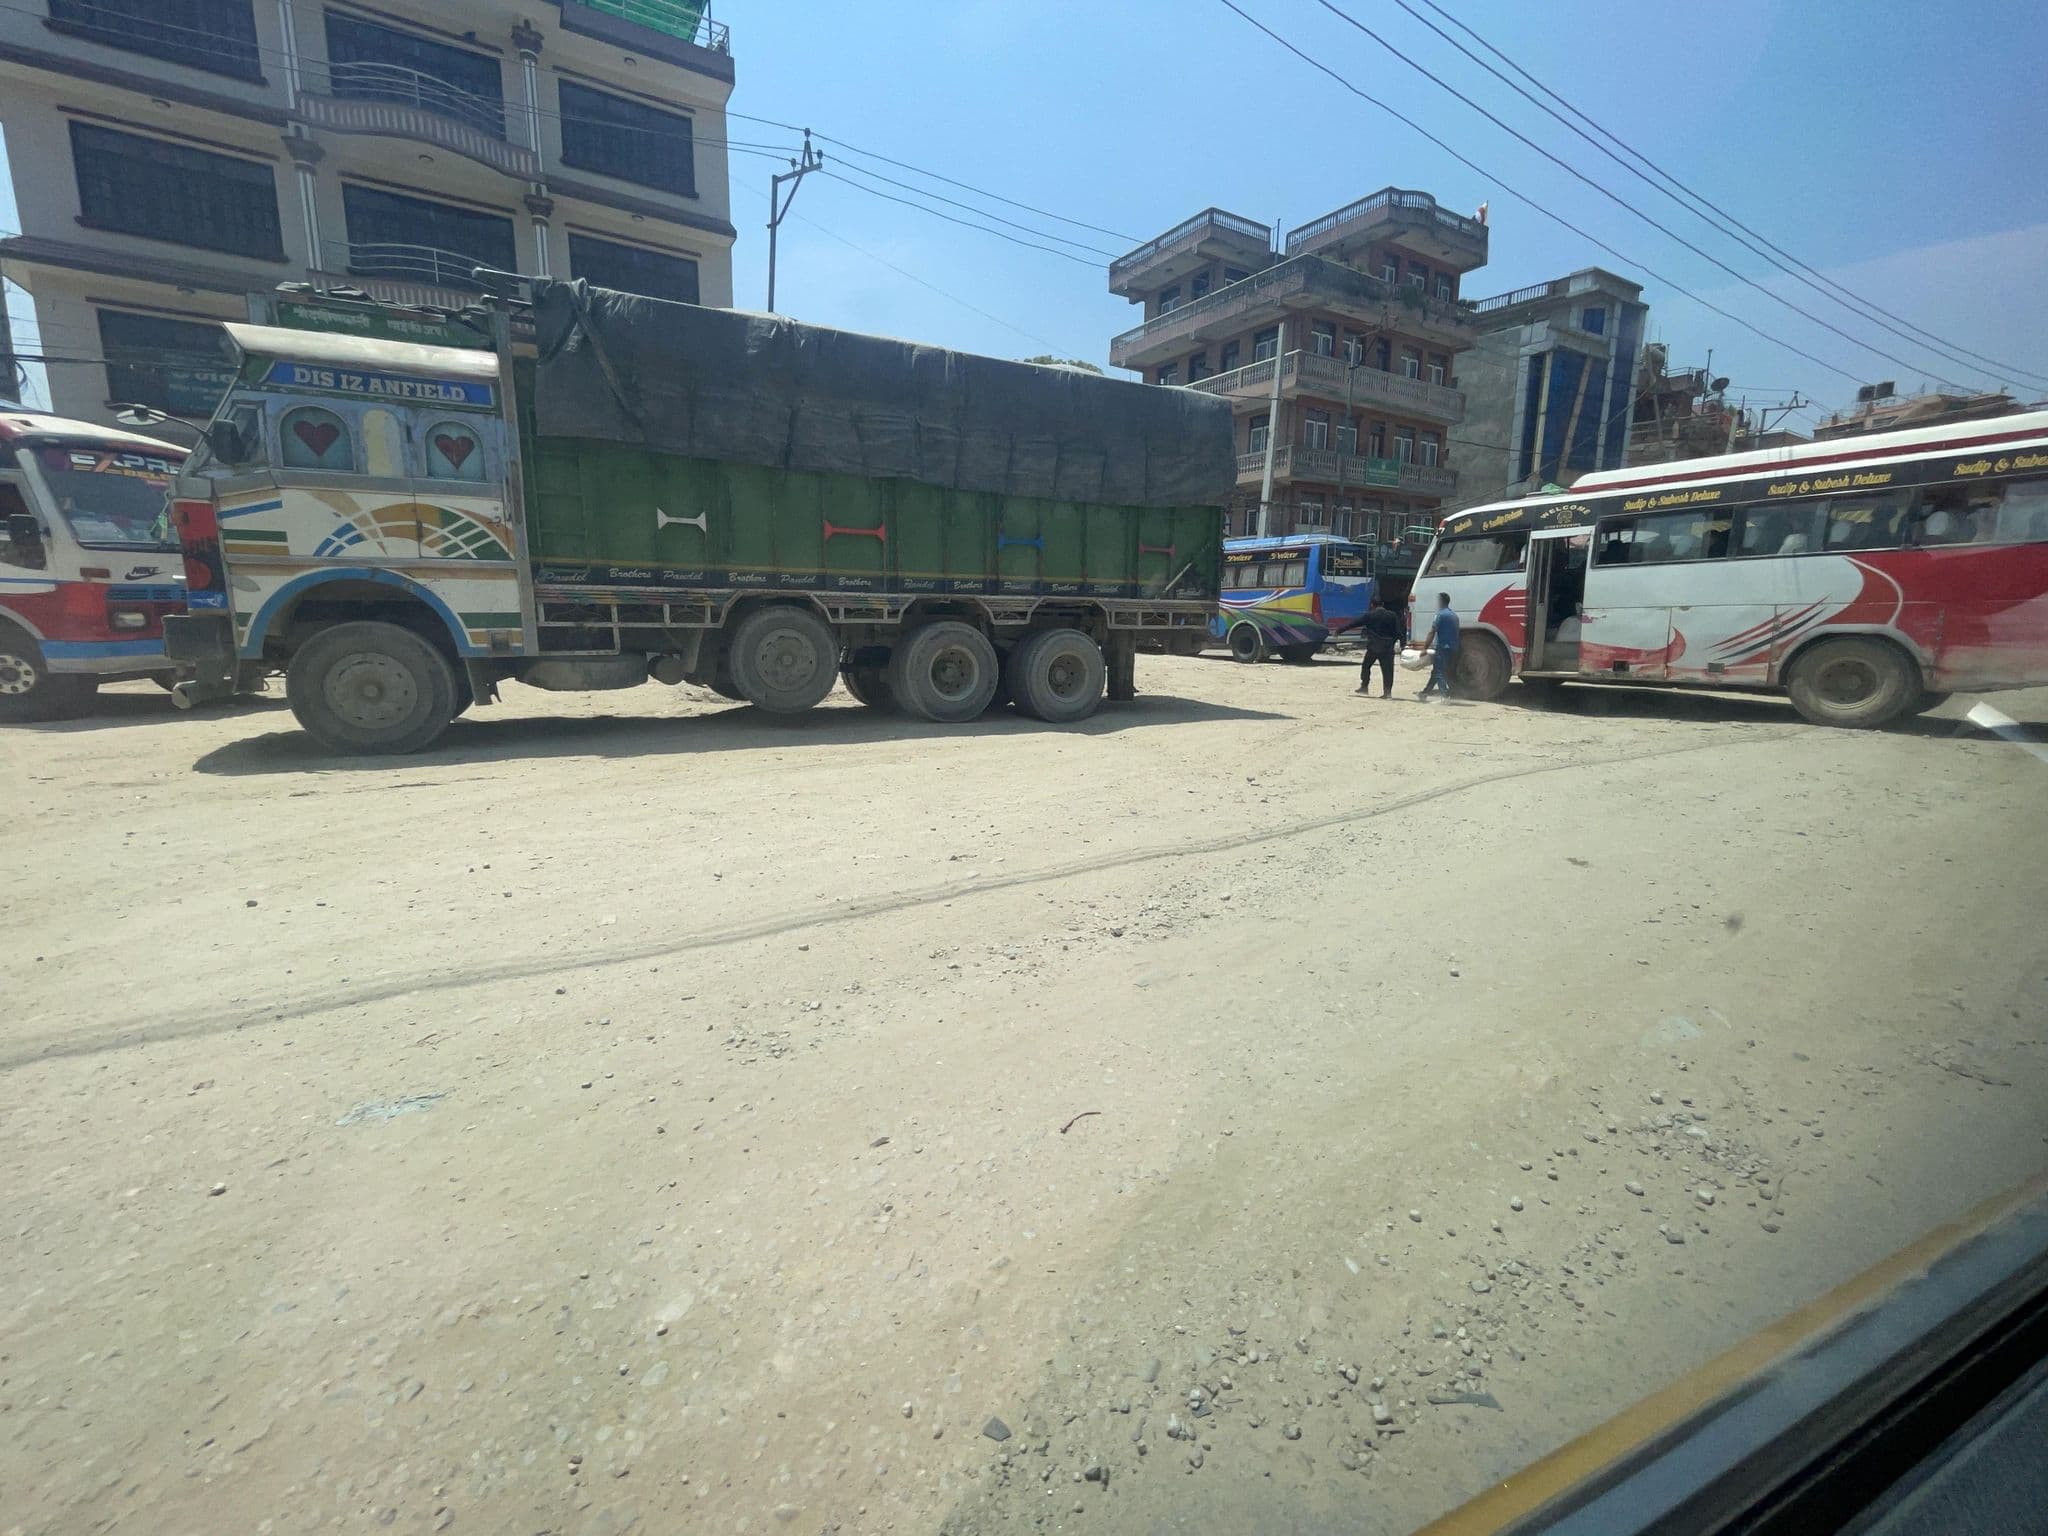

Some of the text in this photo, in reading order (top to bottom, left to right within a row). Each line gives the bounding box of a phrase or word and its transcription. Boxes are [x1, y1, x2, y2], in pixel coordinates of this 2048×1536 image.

[294, 367, 466, 402] DIS IZ ANFIELD
[1994, 457, 2010, 473] &
[1767, 471, 1892, 496] Sudip & Subesh Deluxe
[1690, 489, 1721, 502] Deluxe
[1540, 504, 1592, 519] WELCOME
[608, 567, 652, 579] Brothers
[728, 572, 767, 583] Brothers
[838, 576, 872, 587] Brothers
